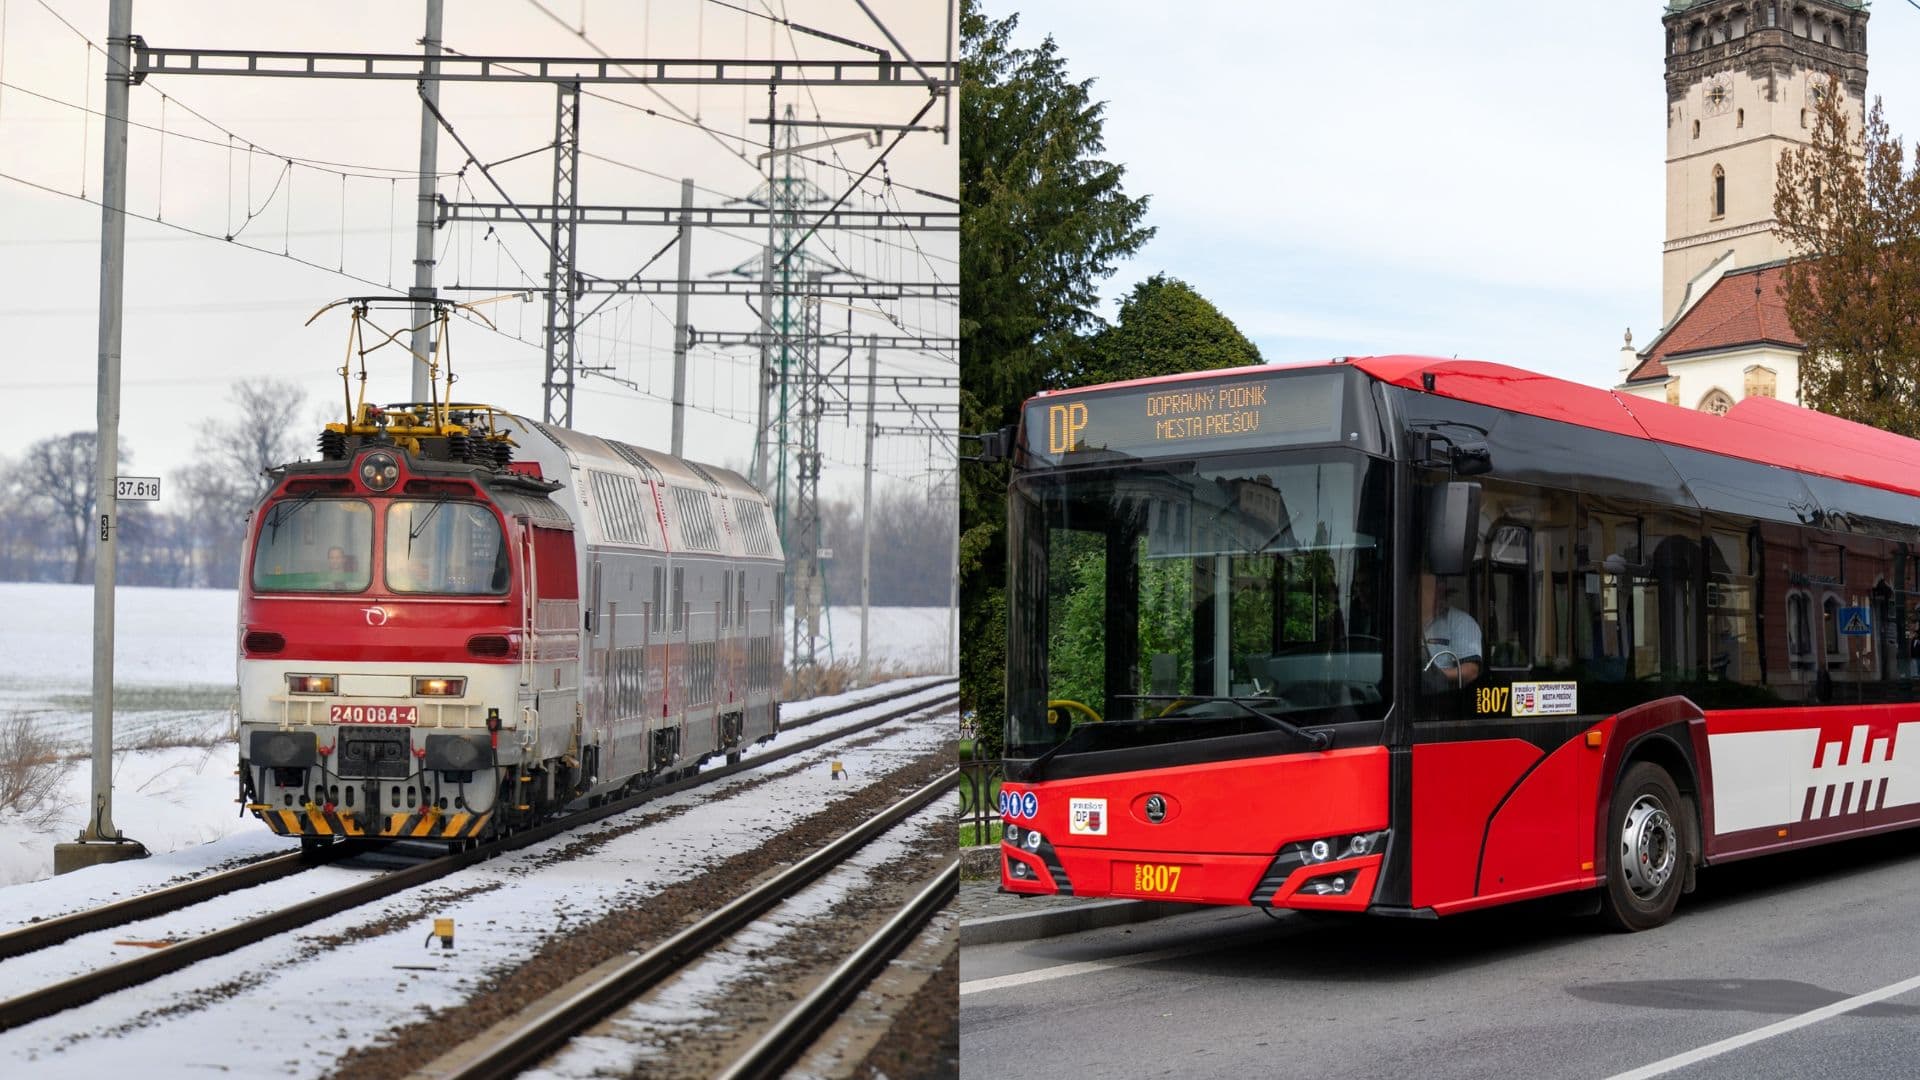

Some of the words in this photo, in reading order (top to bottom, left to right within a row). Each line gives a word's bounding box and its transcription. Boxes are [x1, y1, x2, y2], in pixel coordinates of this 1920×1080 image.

[1147, 389, 1215, 416] DOPRAVNÝ
[1219, 385, 1267, 409] PODNIK
[1049, 403, 1088, 453] DP
[1156, 416, 1202, 439] MESTA
[1206, 410, 1260, 434] PREŠOV
[118, 481, 158, 496] 37.618
[1482, 687, 1509, 713] 807
[332, 706, 363, 722] 240
[366, 707, 416, 723] 084-4
[1076, 810, 1088, 822] DP
[1142, 864, 1182, 893] 807
